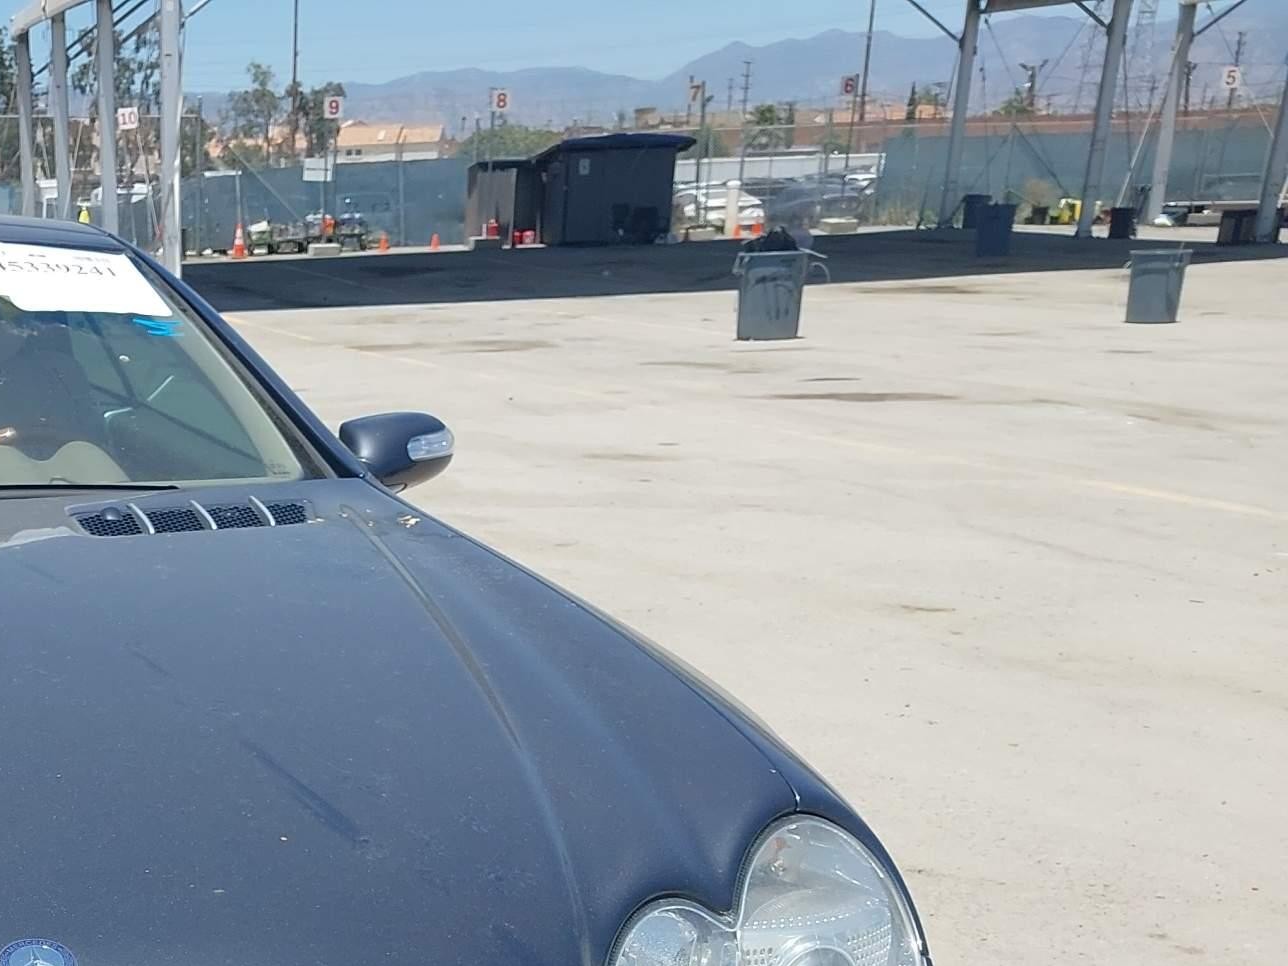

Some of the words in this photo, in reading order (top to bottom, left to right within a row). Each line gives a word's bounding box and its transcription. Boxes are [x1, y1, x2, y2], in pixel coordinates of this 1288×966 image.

[844, 77, 856, 94] 6
[1225, 69, 1237, 86] 5
[329, 99, 340, 116] 9
[496, 92, 508, 109] 8
[120, 111, 137, 125] 10
